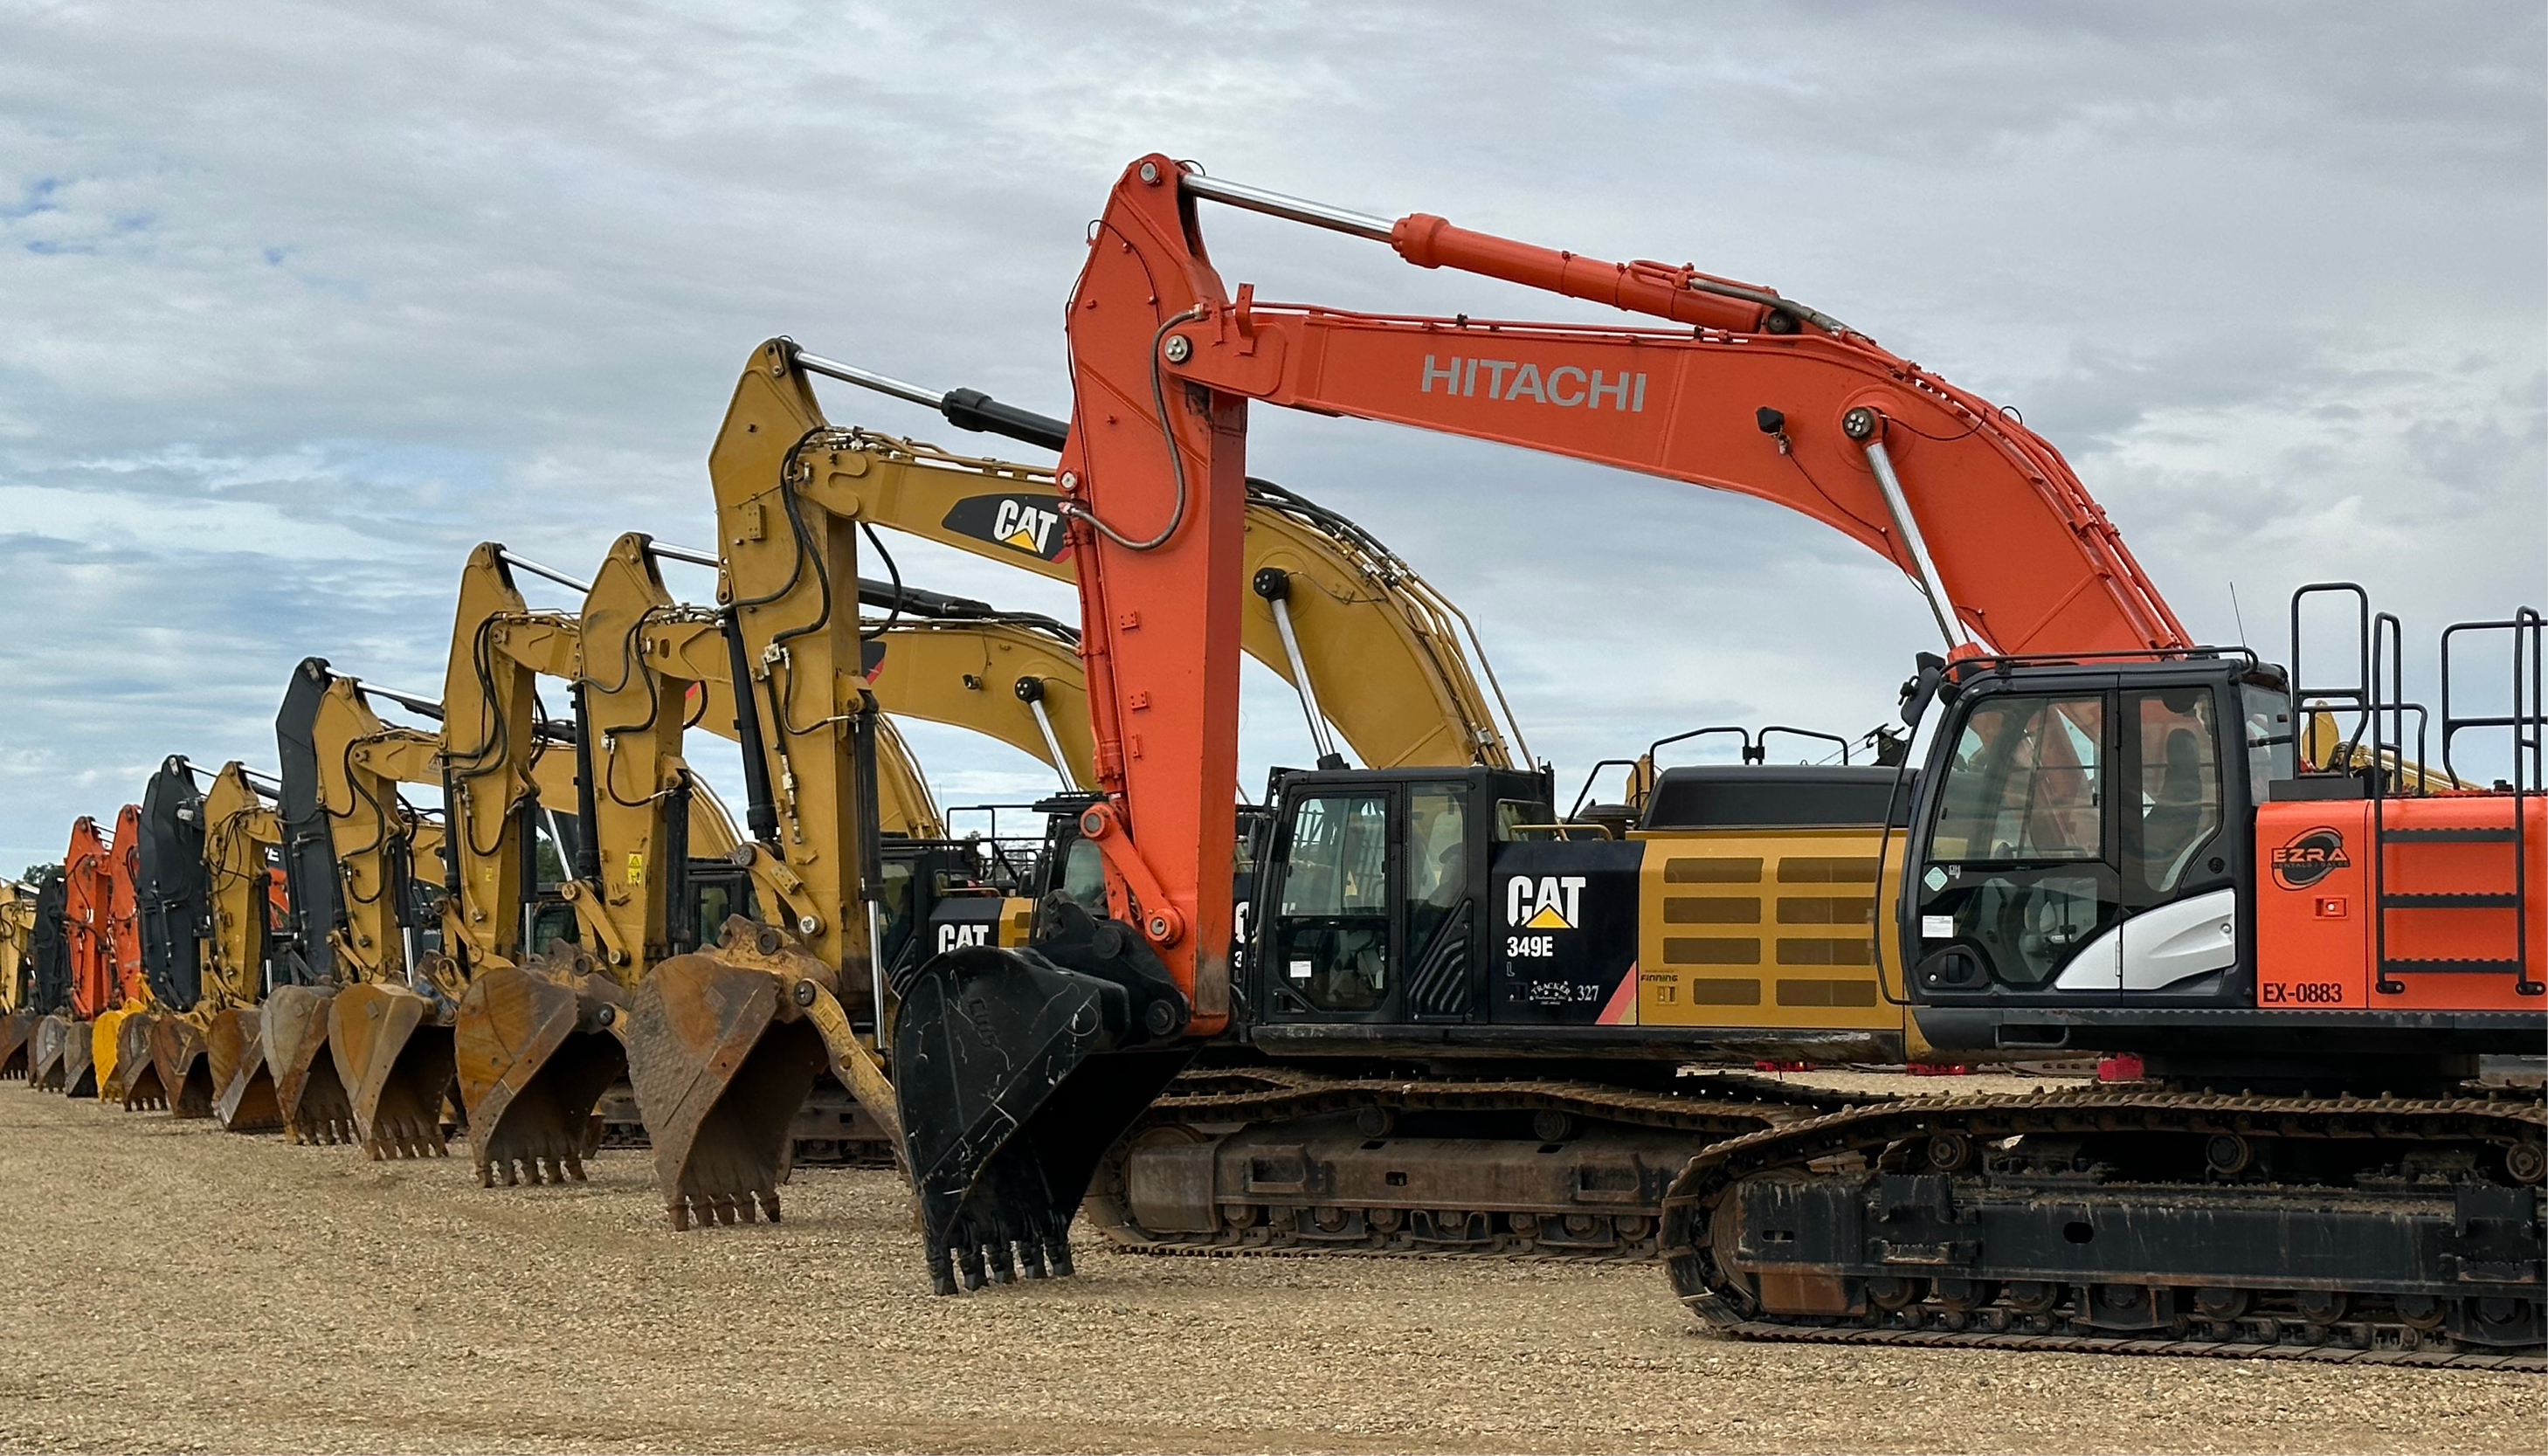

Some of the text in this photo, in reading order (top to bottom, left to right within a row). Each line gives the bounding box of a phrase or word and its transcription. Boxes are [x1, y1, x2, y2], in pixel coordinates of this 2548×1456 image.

[1421, 355, 1647, 412] HITACHI
[994, 500, 1058, 554] CAT
[2273, 848, 2348, 862] EZRA
[1508, 876, 1586, 928] CAT
[939, 924, 989, 954] CAT
[1507, 935, 1553, 957] 349E
[1531, 983, 1599, 1002] TRACKER 327
[2263, 983, 2342, 1003] EX-0883
